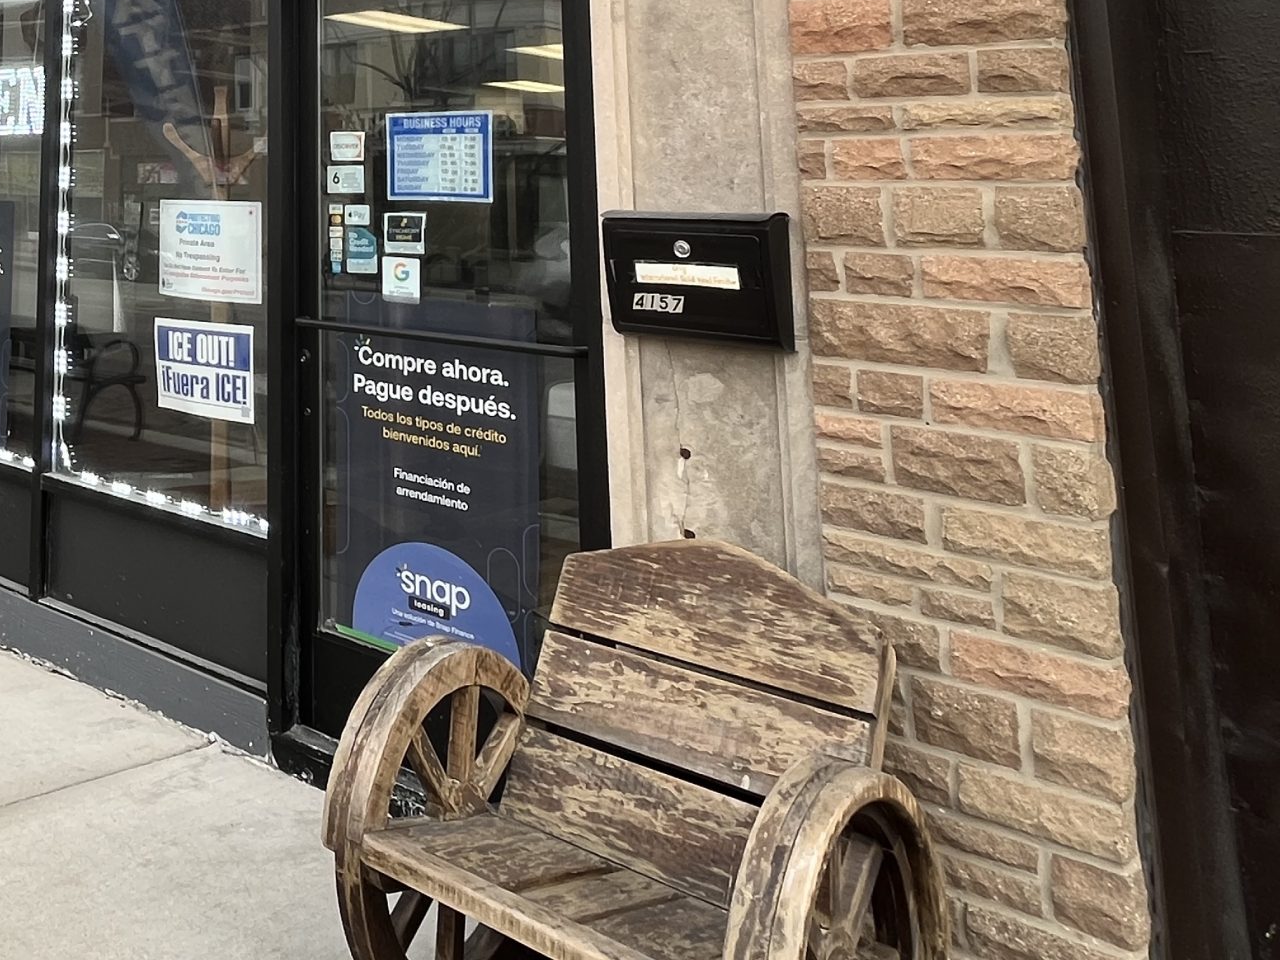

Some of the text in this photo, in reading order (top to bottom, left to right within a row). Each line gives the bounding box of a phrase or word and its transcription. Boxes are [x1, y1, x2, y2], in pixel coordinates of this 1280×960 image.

[403, 117, 481, 129] BUSINESS HOURS
[332, 171, 340, 184] 6
[188, 223, 220, 236] CHICAGO
[393, 262, 410, 282] G
[634, 294, 683, 312] 4157
[168, 330, 235, 368] ICE OUT!
[357, 344, 510, 387] Compre ahora.
[162, 365, 247, 405] ¡Fuera ICE!
[352, 373, 517, 420] Pague después.
[362, 405, 507, 445] Todos los tipos de crédito
[382, 426, 481, 458] bienvenidos aquí.
[393, 467, 471, 495] Financiación de
[396, 485, 469, 511] arrendamiento
[401, 570, 471, 617] snap
[414, 599, 445, 617] leasing
